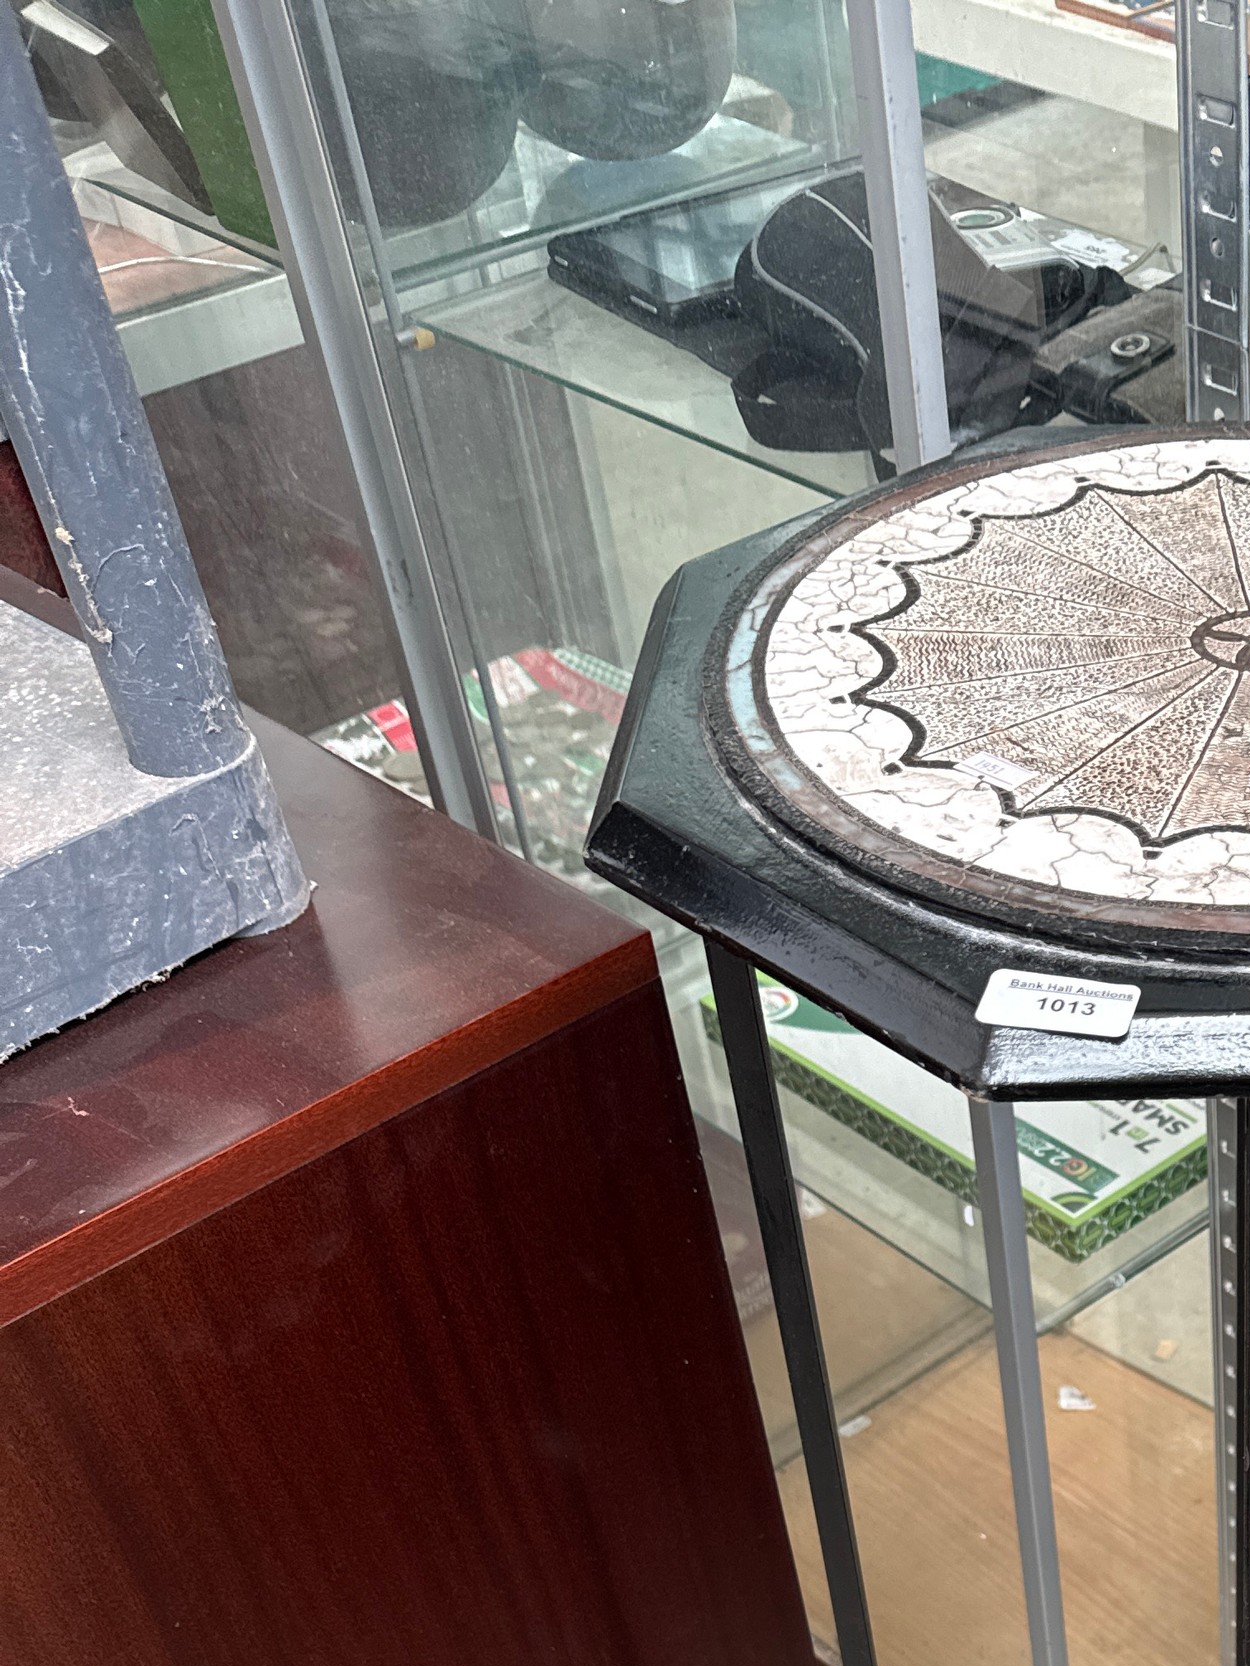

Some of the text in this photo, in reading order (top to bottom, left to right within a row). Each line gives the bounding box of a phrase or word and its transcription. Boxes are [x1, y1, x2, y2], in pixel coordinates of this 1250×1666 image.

[1009, 978, 1134, 1001] Bank Hall Auctions
[1036, 997, 1097, 1016] 1013
